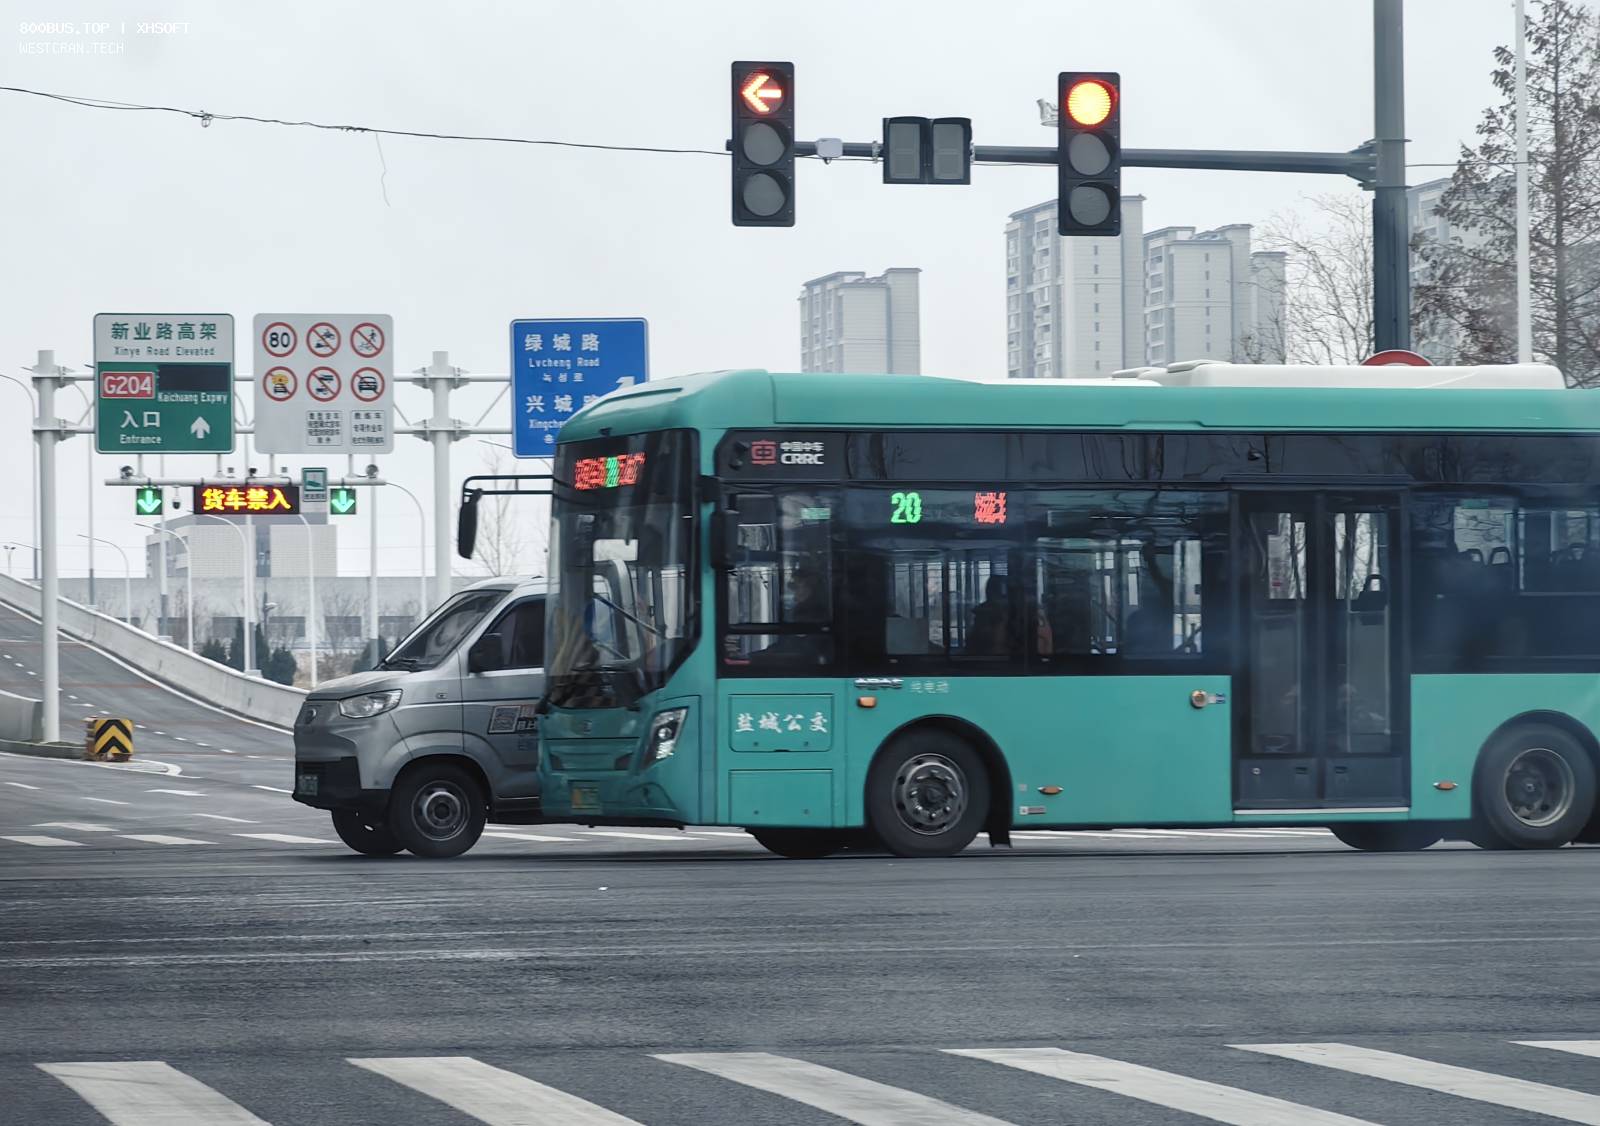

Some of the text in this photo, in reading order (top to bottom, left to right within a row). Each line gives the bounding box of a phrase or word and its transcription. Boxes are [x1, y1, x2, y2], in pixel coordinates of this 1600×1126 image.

[111, 322, 217, 341] 新业路高架
[269, 332, 290, 348] 80
[524, 333, 600, 352] 绿城路
[114, 346, 215, 358] Xinye Road Elevated
[528, 357, 600, 370] Lvcheng Road
[103, 375, 152, 395] G204
[157, 393, 228, 405] Kaichuang Expwy
[120, 410, 161, 428] 入口
[528, 419, 568, 431] Xingche
[120, 434, 161, 444] Entrance
[780, 453, 825, 465] CRRC
[202, 488, 291, 511] 货车禁入
[890, 492, 923, 524] 20
[735, 711, 828, 734] 盐城公交
